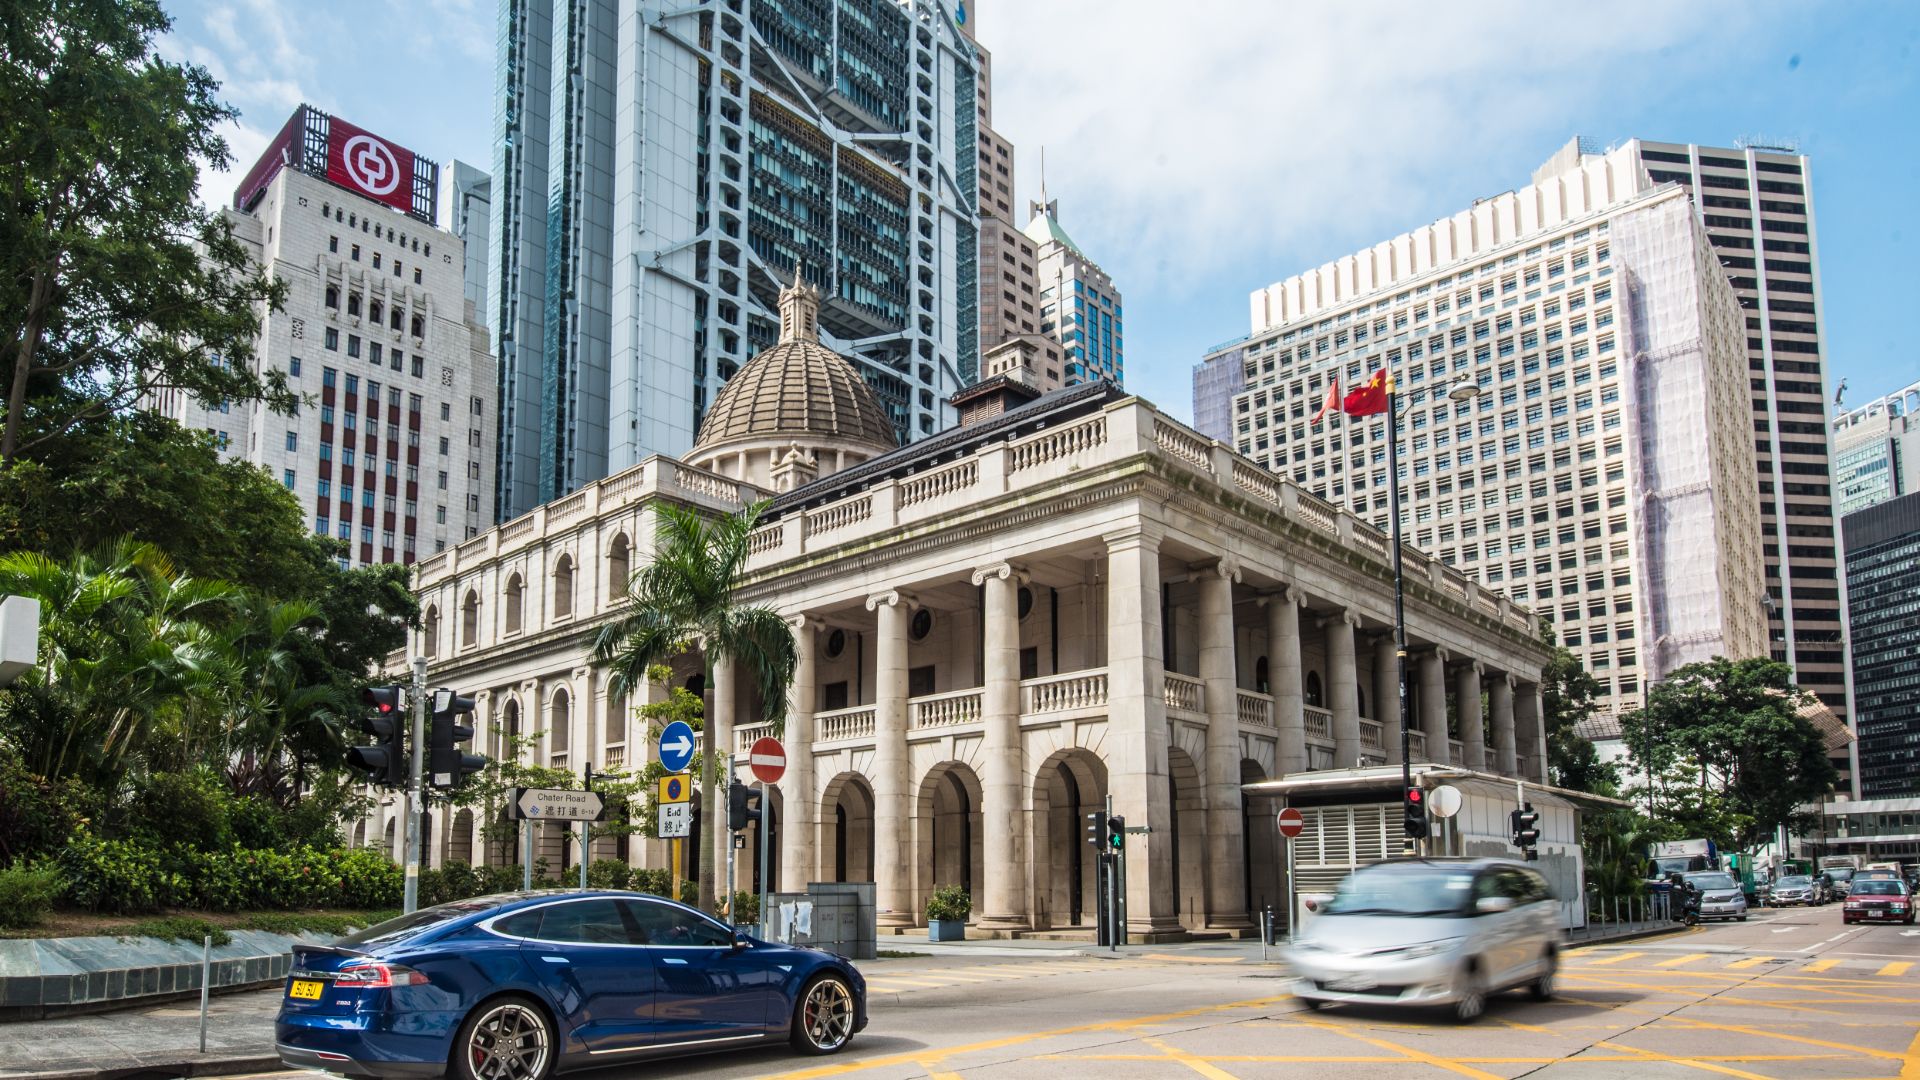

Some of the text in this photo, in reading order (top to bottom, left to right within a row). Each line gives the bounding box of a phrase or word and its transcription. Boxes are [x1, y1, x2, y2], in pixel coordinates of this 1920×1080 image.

[538, 793, 586, 803] Chater Road
[545, 805, 578, 817] 遮打道
